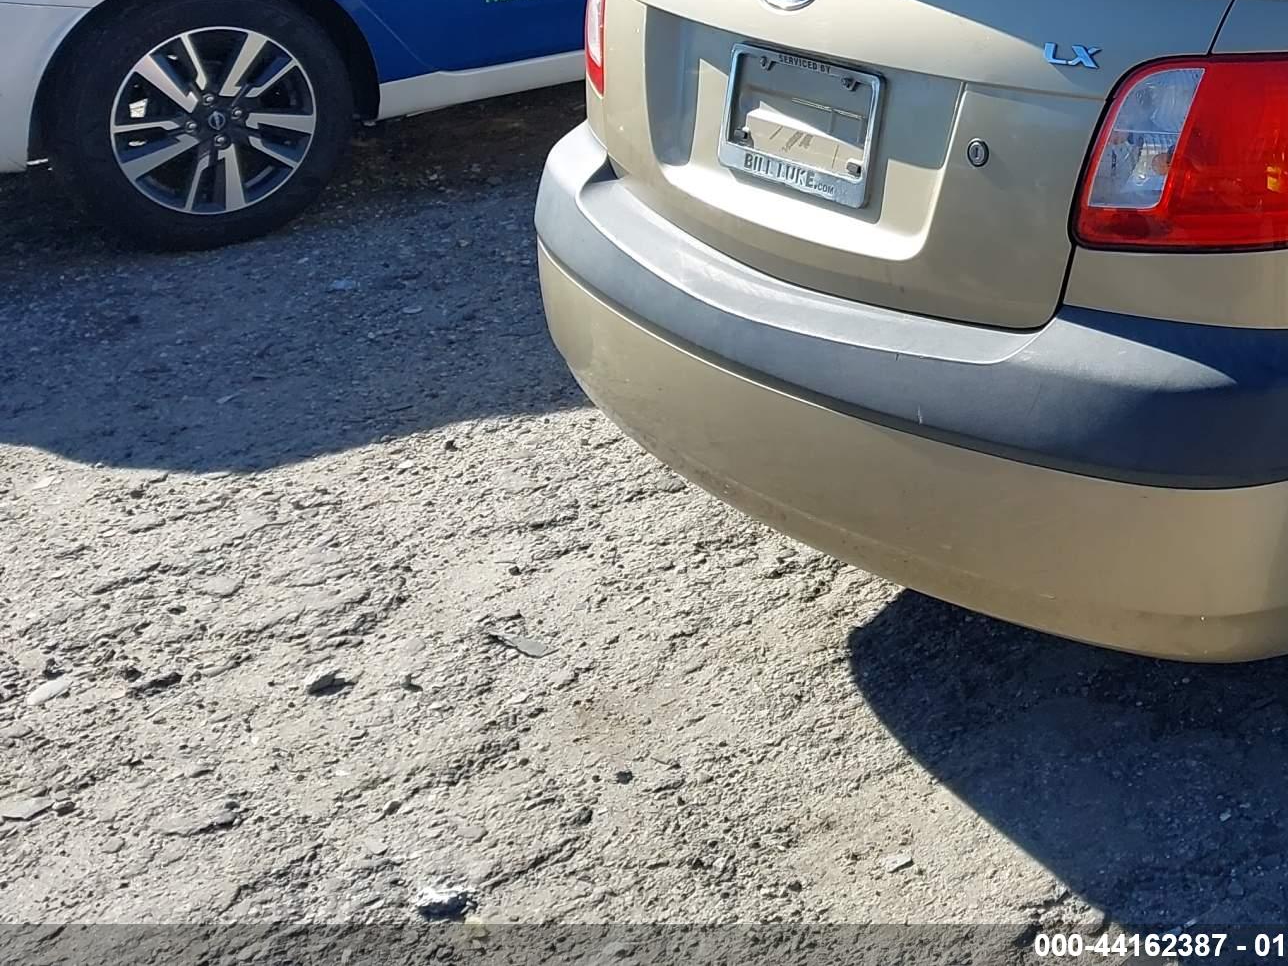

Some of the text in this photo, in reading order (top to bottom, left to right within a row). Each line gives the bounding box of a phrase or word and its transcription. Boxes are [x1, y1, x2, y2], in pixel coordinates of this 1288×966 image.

[778, 54, 831, 74] SERVICED BY
[1044, 42, 1102, 69] LX
[743, 153, 773, 177] BILL
